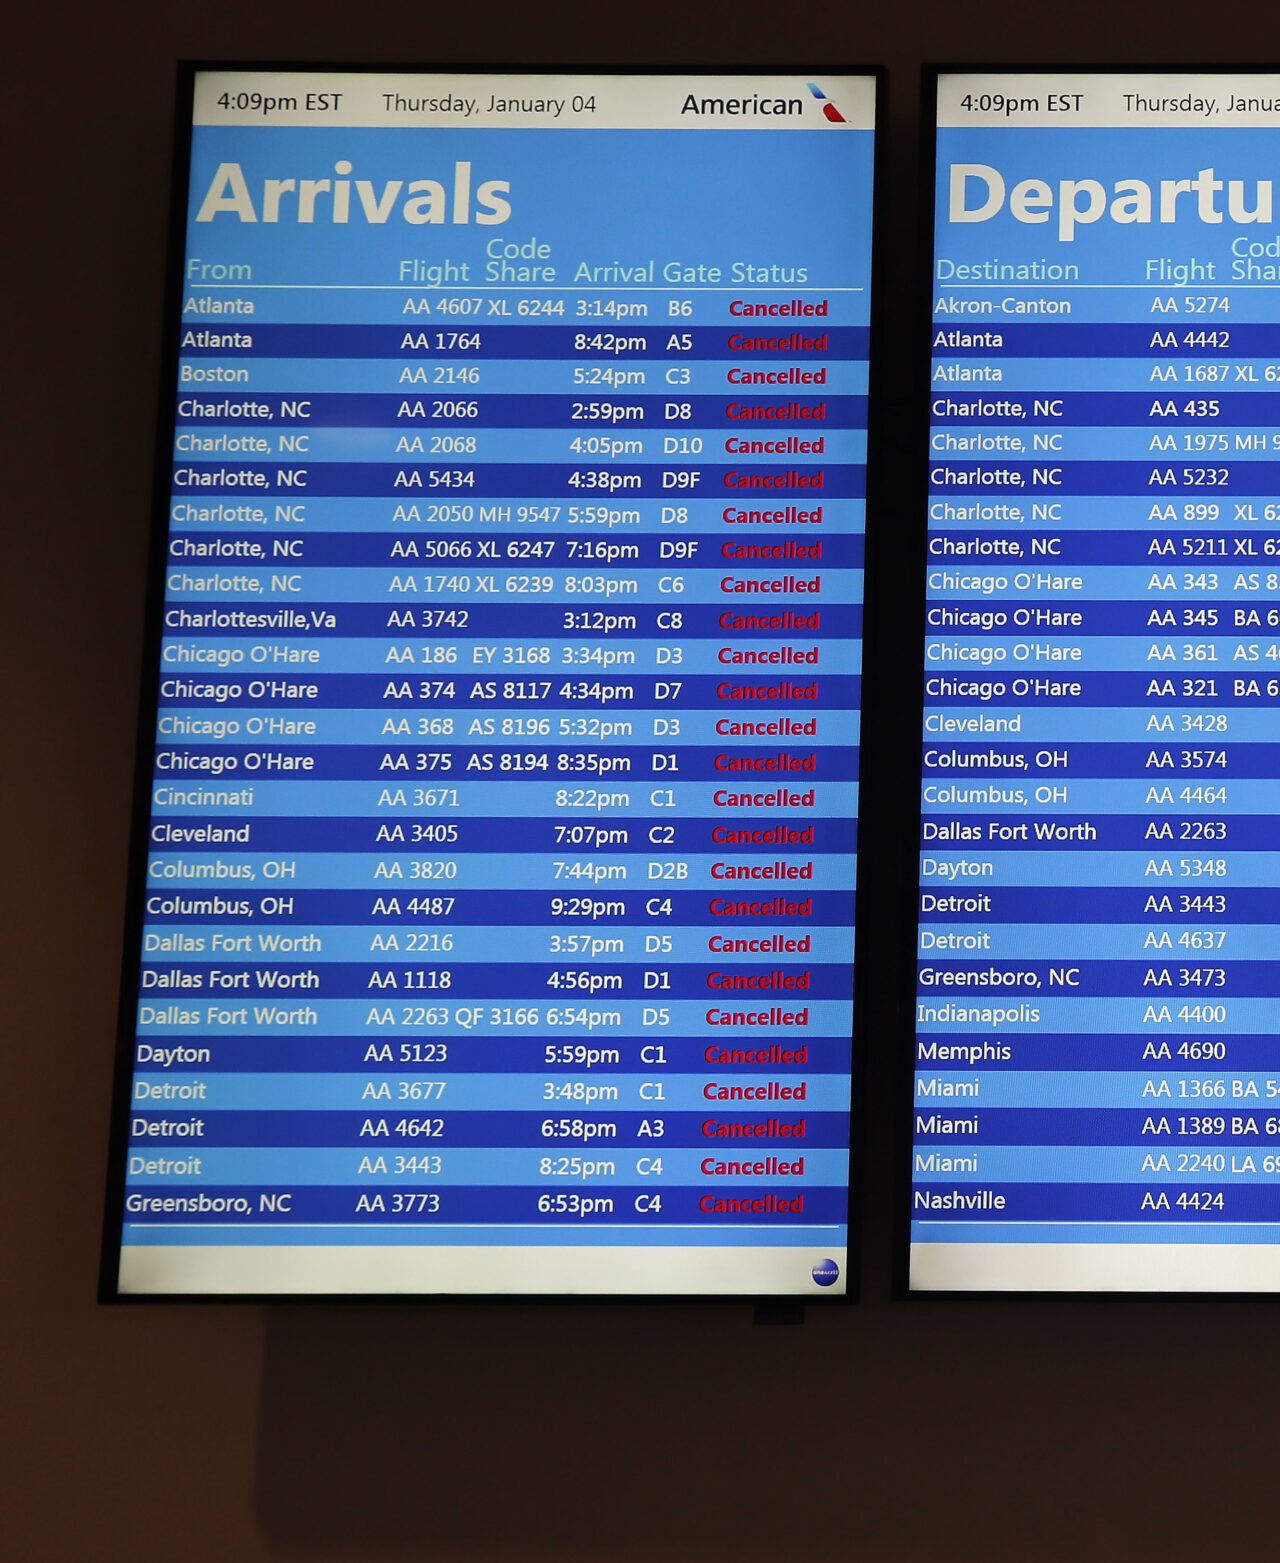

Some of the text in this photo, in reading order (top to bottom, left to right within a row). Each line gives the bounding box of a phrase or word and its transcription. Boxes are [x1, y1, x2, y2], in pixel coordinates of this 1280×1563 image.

[217, 93, 342, 115] 4:09pm EST
[383, 94, 596, 117] Thursday, January 04
[681, 94, 802, 115] American
[960, 95, 1084, 116] 4:09pm EST
[1123, 94, 1219, 116] Thursday,
[197, 161, 511, 225] Arrivals
[487, 237, 551, 259] Code
[189, 259, 807, 285] From Flight Share Arrival Gate Status
[938, 259, 1078, 279] Destination
[1147, 258, 1216, 284] Flight
[184, 297, 828, 320] Atlanta AA 4607 XL 6244 3:14pm B6 Cancelled
[933, 297, 1071, 316] Akron-Canton
[1151, 297, 1178, 312] AA
[1185, 297, 1230, 312] 5274
[170, 539, 822, 562] Charlotte, NC AA 5066 XL 6247 7:16pm D9F Cancelled
[929, 538, 1023, 557] Charlotte,
[1032, 539, 1060, 554] NC
[1148, 539, 1176, 555] AA
[1183, 539, 1227, 555] 5211
[1234, 539, 1258, 555] XL
[924, 713, 1022, 734] Cleveland
[1146, 715, 1174, 731] AA
[1182, 715, 1227, 731] 3428
[924, 822, 981, 839] Dallas
[990, 823, 1028, 839] Fort
[1034, 822, 1096, 840] Worth
[1145, 822, 1173, 839] AA
[1180, 823, 1226, 839] 2263
[140, 1007, 809, 1030] Dallas Fort Worth AA 2263 QF 3166 6:54pm D5 Cancelled
[916, 1004, 1041, 1027] Indianapolis
[1143, 1006, 1172, 1022] AA
[1178, 1006, 1226, 1022] 4400
[916, 1154, 977, 1172] Miami
[1142, 1154, 1171, 1171] AA
[1177, 1154, 1225, 1171] 2240
[1232, 1156, 1256, 1172] LA
[126, 1194, 803, 1217] Greensboro, NC AA 3773 6:53pm C4 Cancelled
